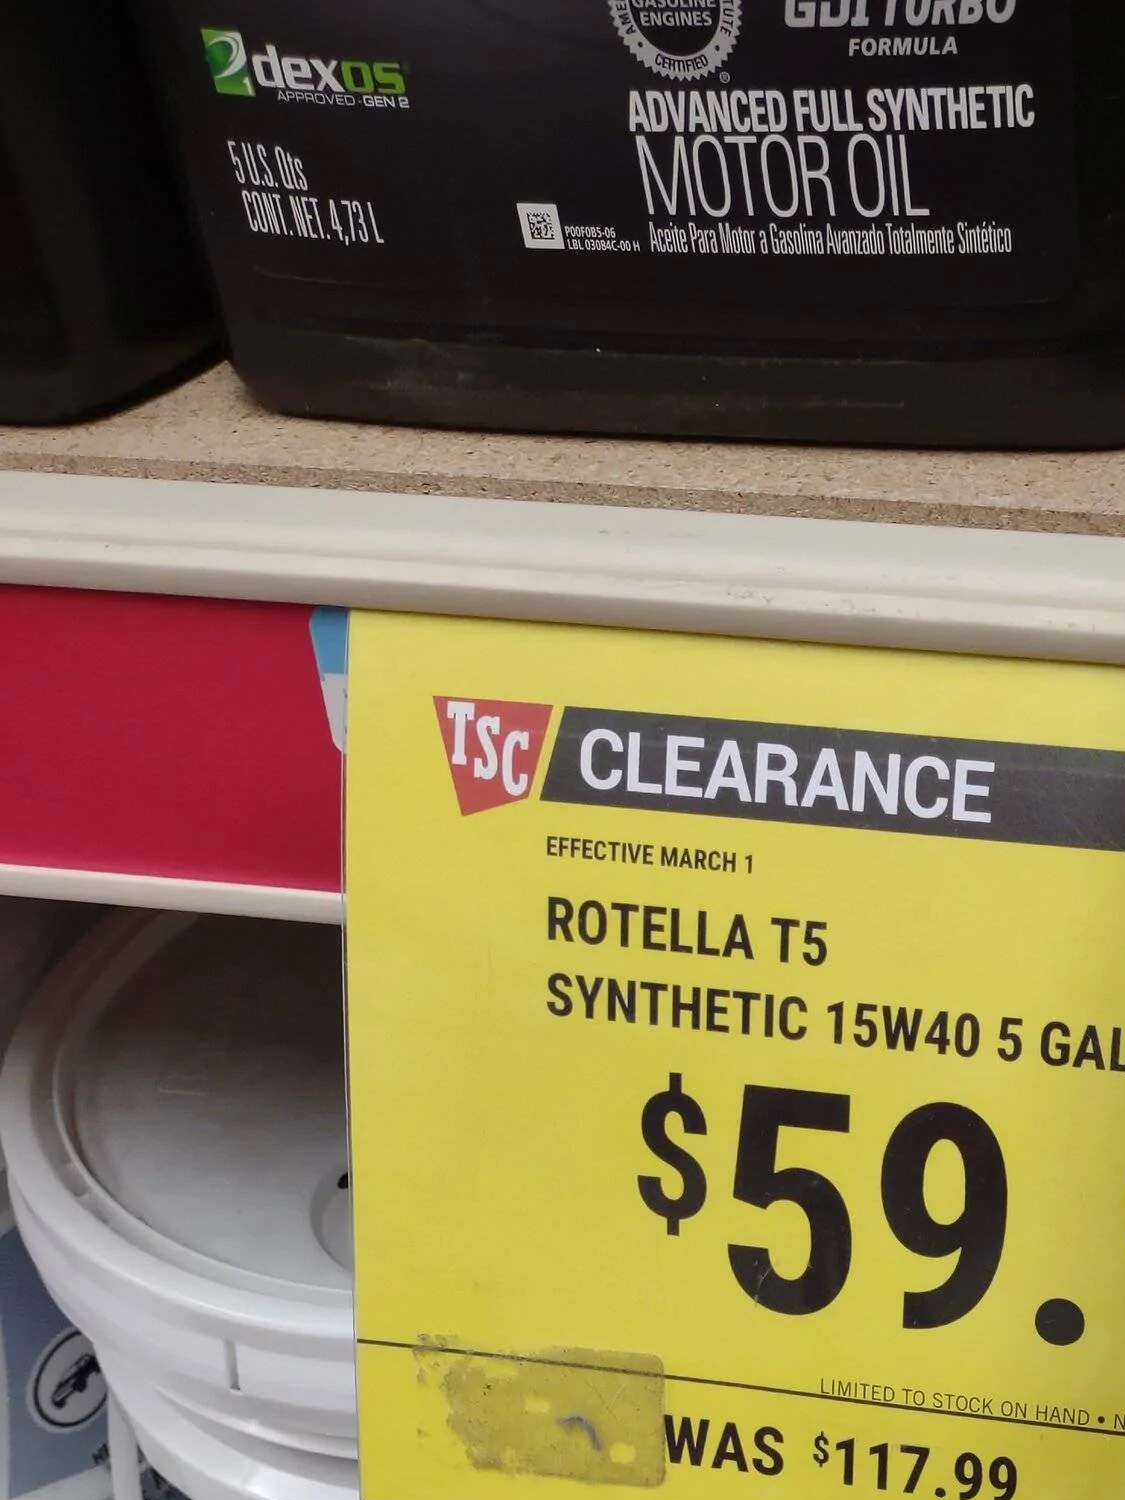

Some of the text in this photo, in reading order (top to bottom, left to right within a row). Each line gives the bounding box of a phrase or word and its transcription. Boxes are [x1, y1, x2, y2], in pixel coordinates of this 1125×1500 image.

[640, 10, 713, 27] ENGINES
[251, 43, 406, 95] dexos
[655, 53, 708, 73] CERTIFIED
[848, 36, 958, 56] FORMULA
[277, 90, 356, 106] APPROVED
[628, 84, 1036, 134] ADVANCED FULL SYNTHETIC
[227, 140, 308, 191] 5 U.S. Qts
[635, 133, 930, 218] MOTOR OIL
[241, 190, 293, 238] CONT.
[367, 202, 385, 244] L
[648, 220, 1013, 256] Aceite Para Motor a Gasolina Avanzado Totalmente Sintético
[566, 238, 585, 250] LBL
[445, 700, 533, 798] TSC
[579, 728, 996, 824] CLEARANCE
[545, 836, 754, 875] EFFECTIVE MARCH 1
[546, 896, 828, 967] ROTELLA T5
[546, 974, 808, 1042] SYNTHETIC
[827, 1000, 980, 1059] 15W40
[997, 1015, 1024, 1063] 5
[820, 1378, 895, 1403] LIMITED
[901, 1387, 926, 1407] TO
[932, 1391, 994, 1415] STOCK
[1000, 1400, 1028, 1419] ON
[1034, 1403, 1091, 1426] HAND
[664, 1413, 785, 1476] WAS
